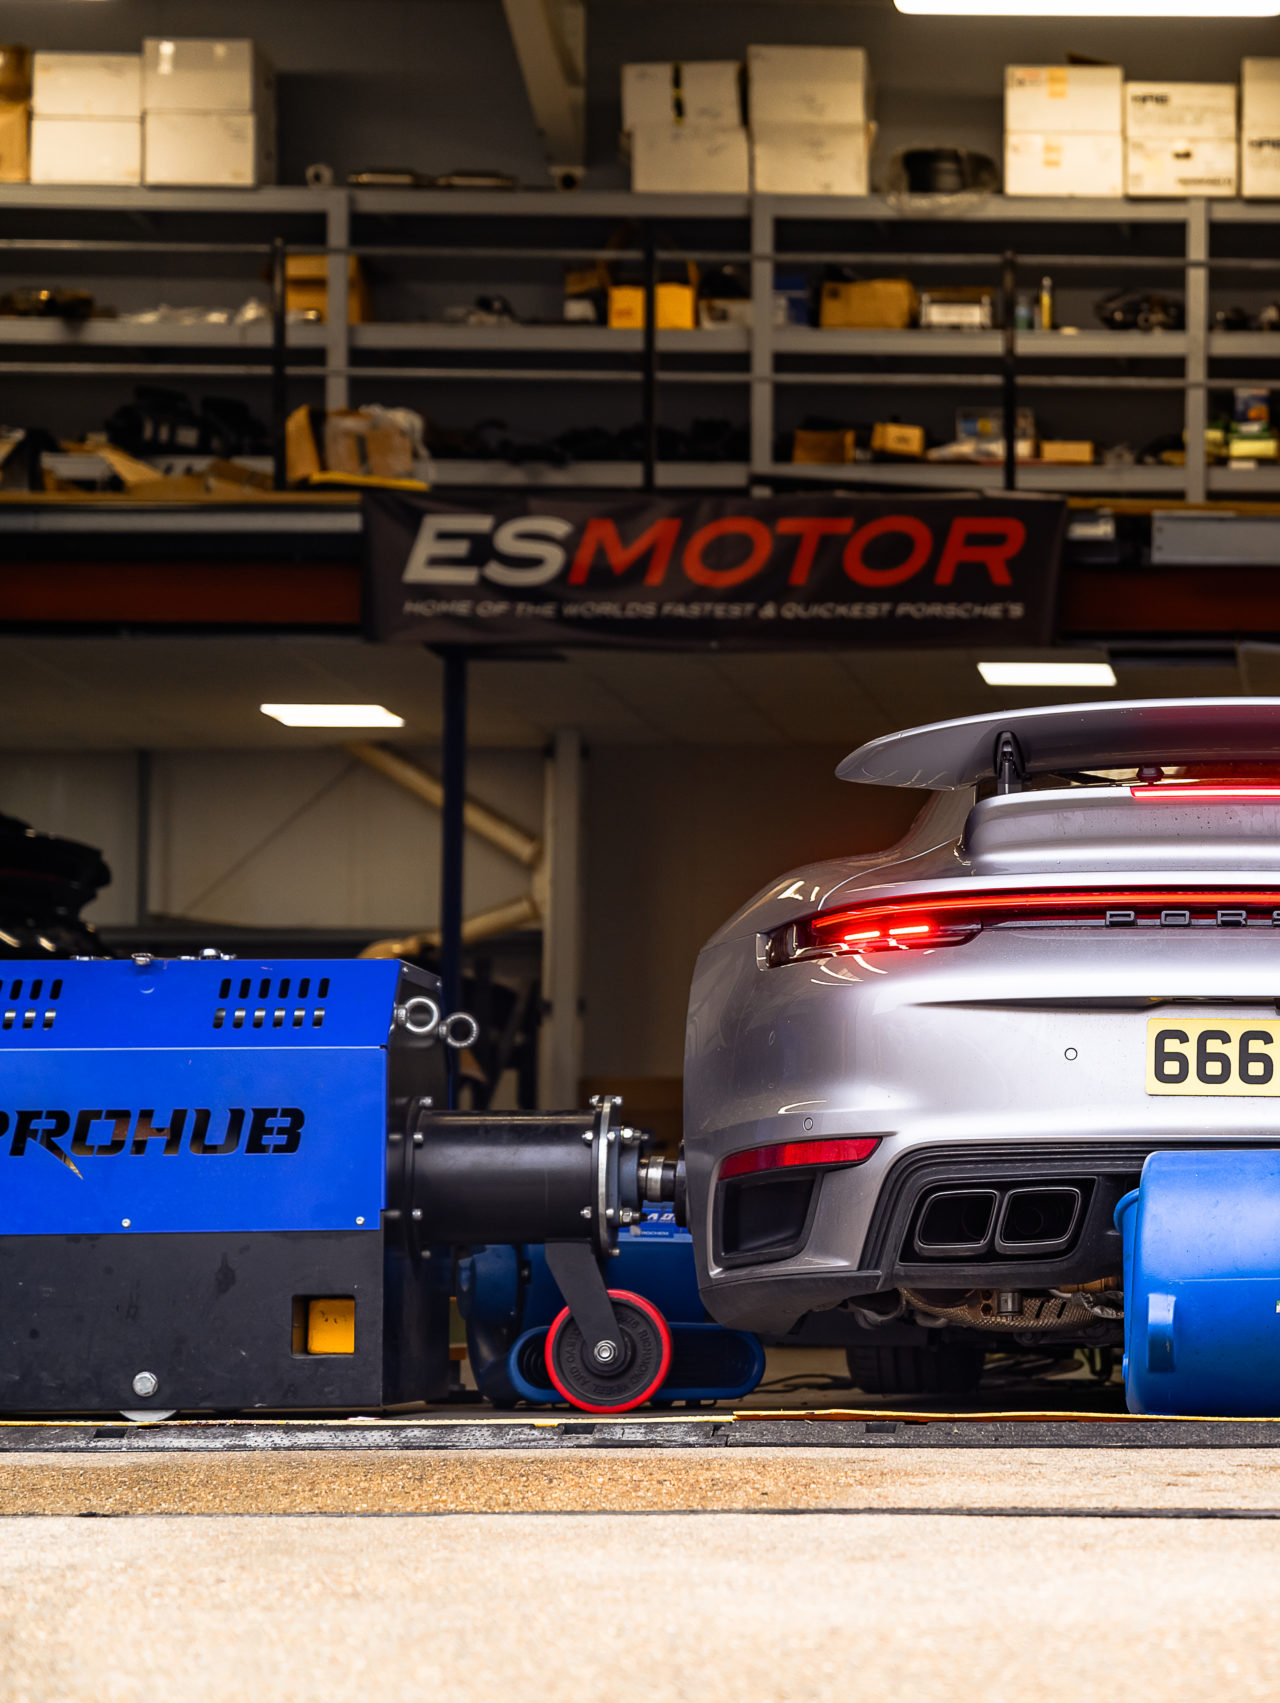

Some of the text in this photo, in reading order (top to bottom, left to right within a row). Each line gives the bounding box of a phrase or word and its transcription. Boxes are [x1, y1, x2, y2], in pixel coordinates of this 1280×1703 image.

[402, 599, 1025, 620] HOME OF THE WORLDS FASTEST & QUICKEST PORSCHE'S
[1154, 1029, 1274, 1085] 666
